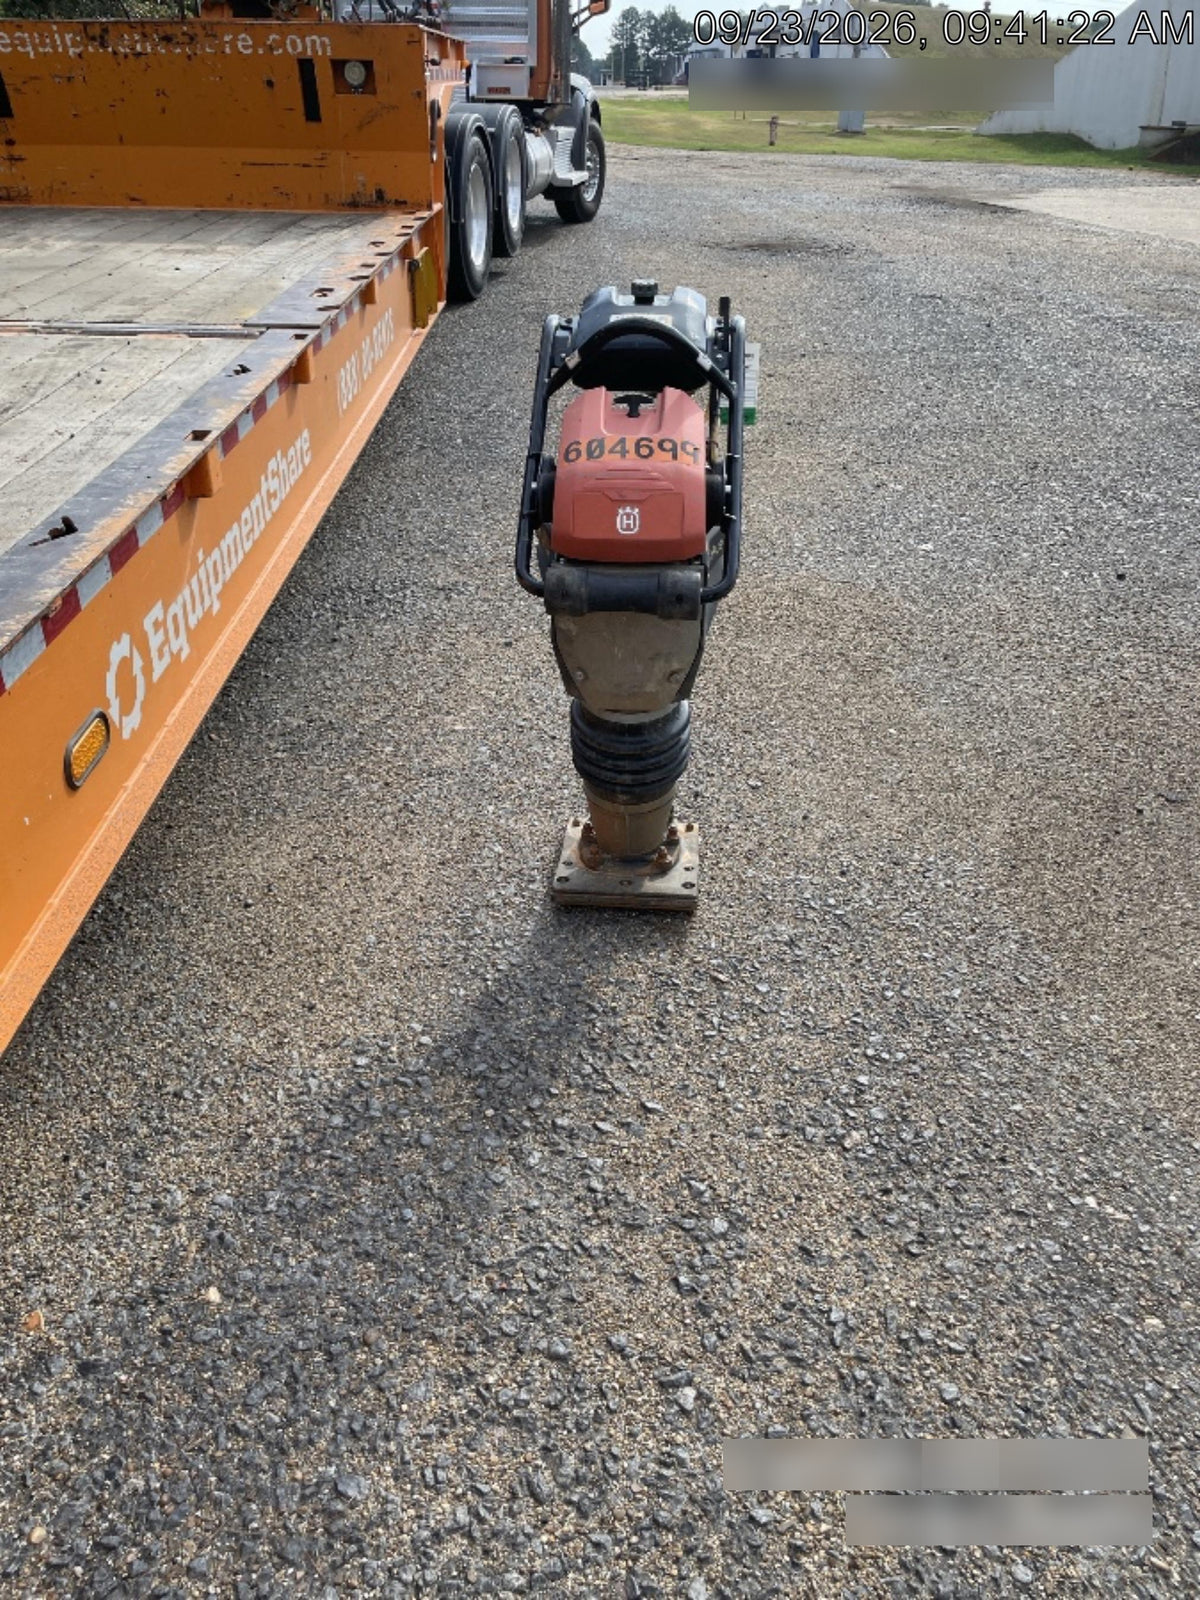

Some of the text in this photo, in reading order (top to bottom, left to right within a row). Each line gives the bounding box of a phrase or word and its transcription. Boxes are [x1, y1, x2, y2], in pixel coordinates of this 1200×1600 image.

[0, 24, 332, 59] equipentre.com
[563, 436, 700, 465] 604699
[143, 428, 312, 683] EquipmentShare
